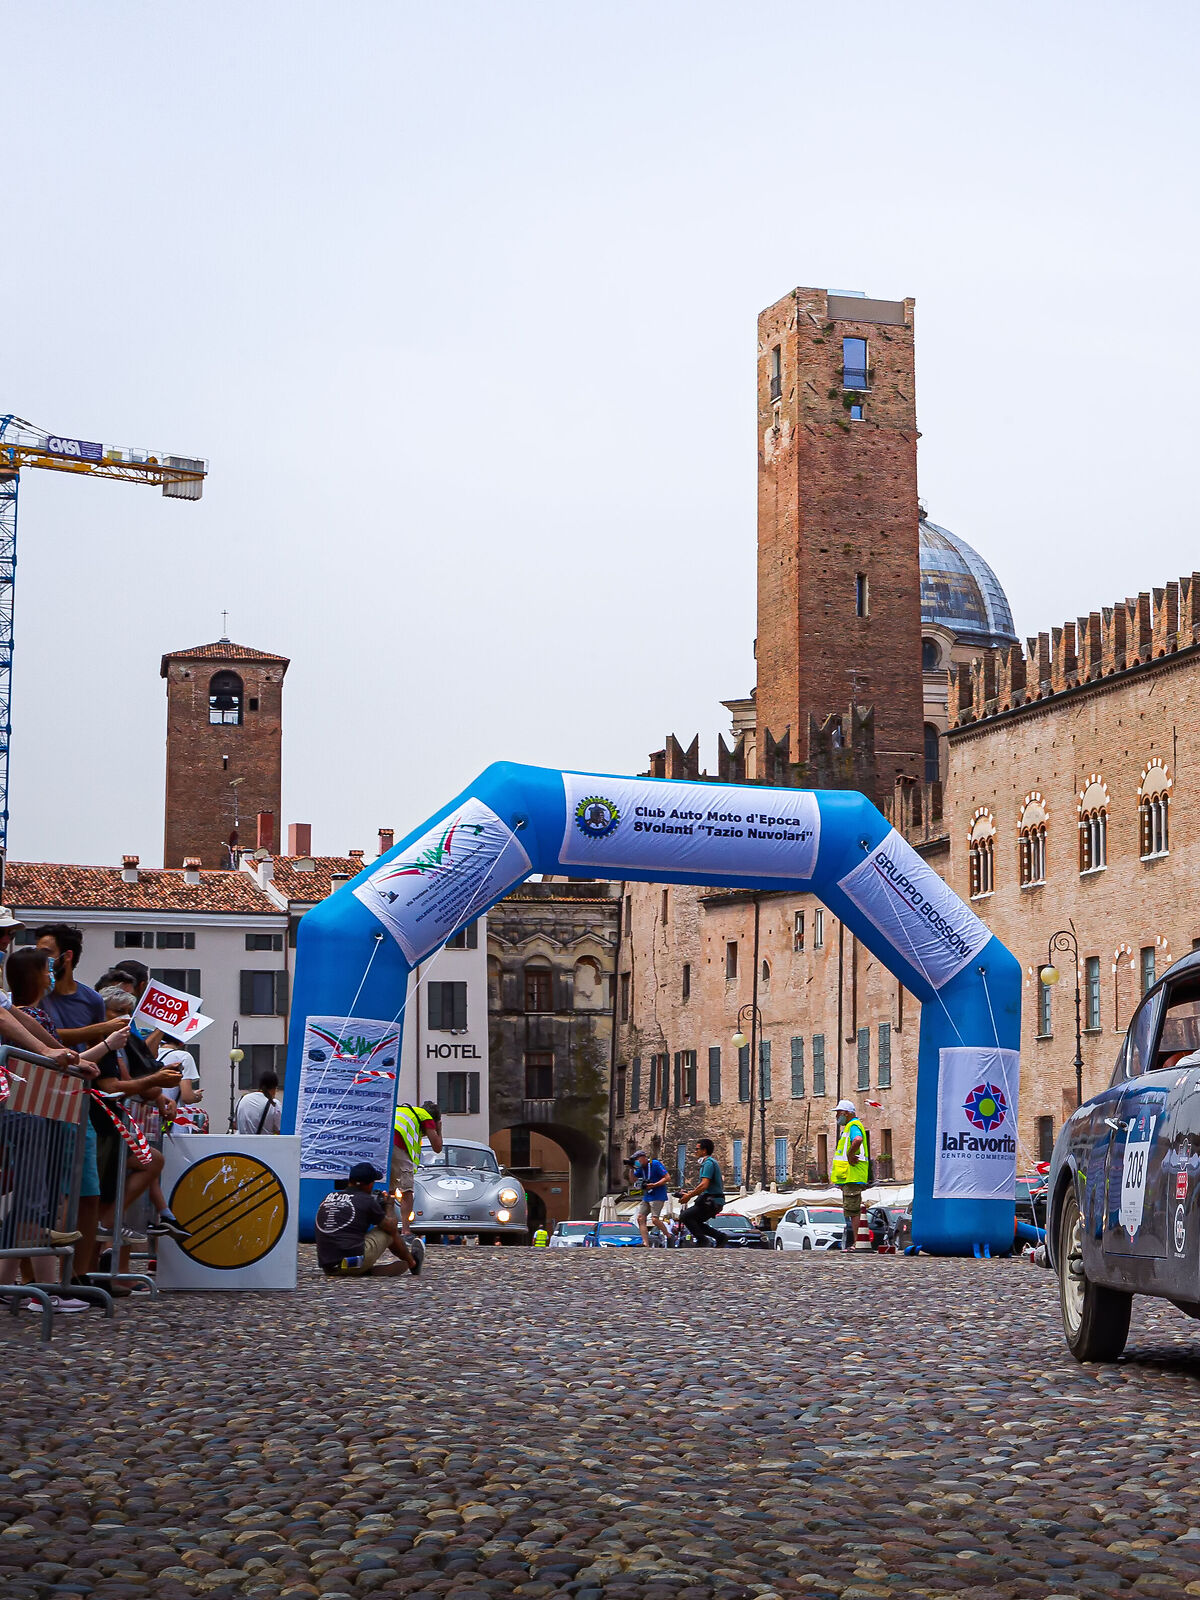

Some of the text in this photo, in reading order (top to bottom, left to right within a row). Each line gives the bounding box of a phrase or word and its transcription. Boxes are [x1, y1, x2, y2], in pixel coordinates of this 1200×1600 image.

[634, 806, 800, 827] Club Auto Moto d'Epoca
[633, 821, 813, 842] 8Volanti "Tazio Nuvolari"
[875, 852, 973, 958] GRUPPO BOSSONI
[152, 992, 182, 1010] 1000
[143, 1002, 178, 1023] MIGLIA
[426, 1044, 482, 1059] HOTEL
[310, 1102, 364, 1111] PIATTAFORME
[942, 1132, 1016, 1153] laFavorita
[1126, 1150, 1144, 1188] 208
